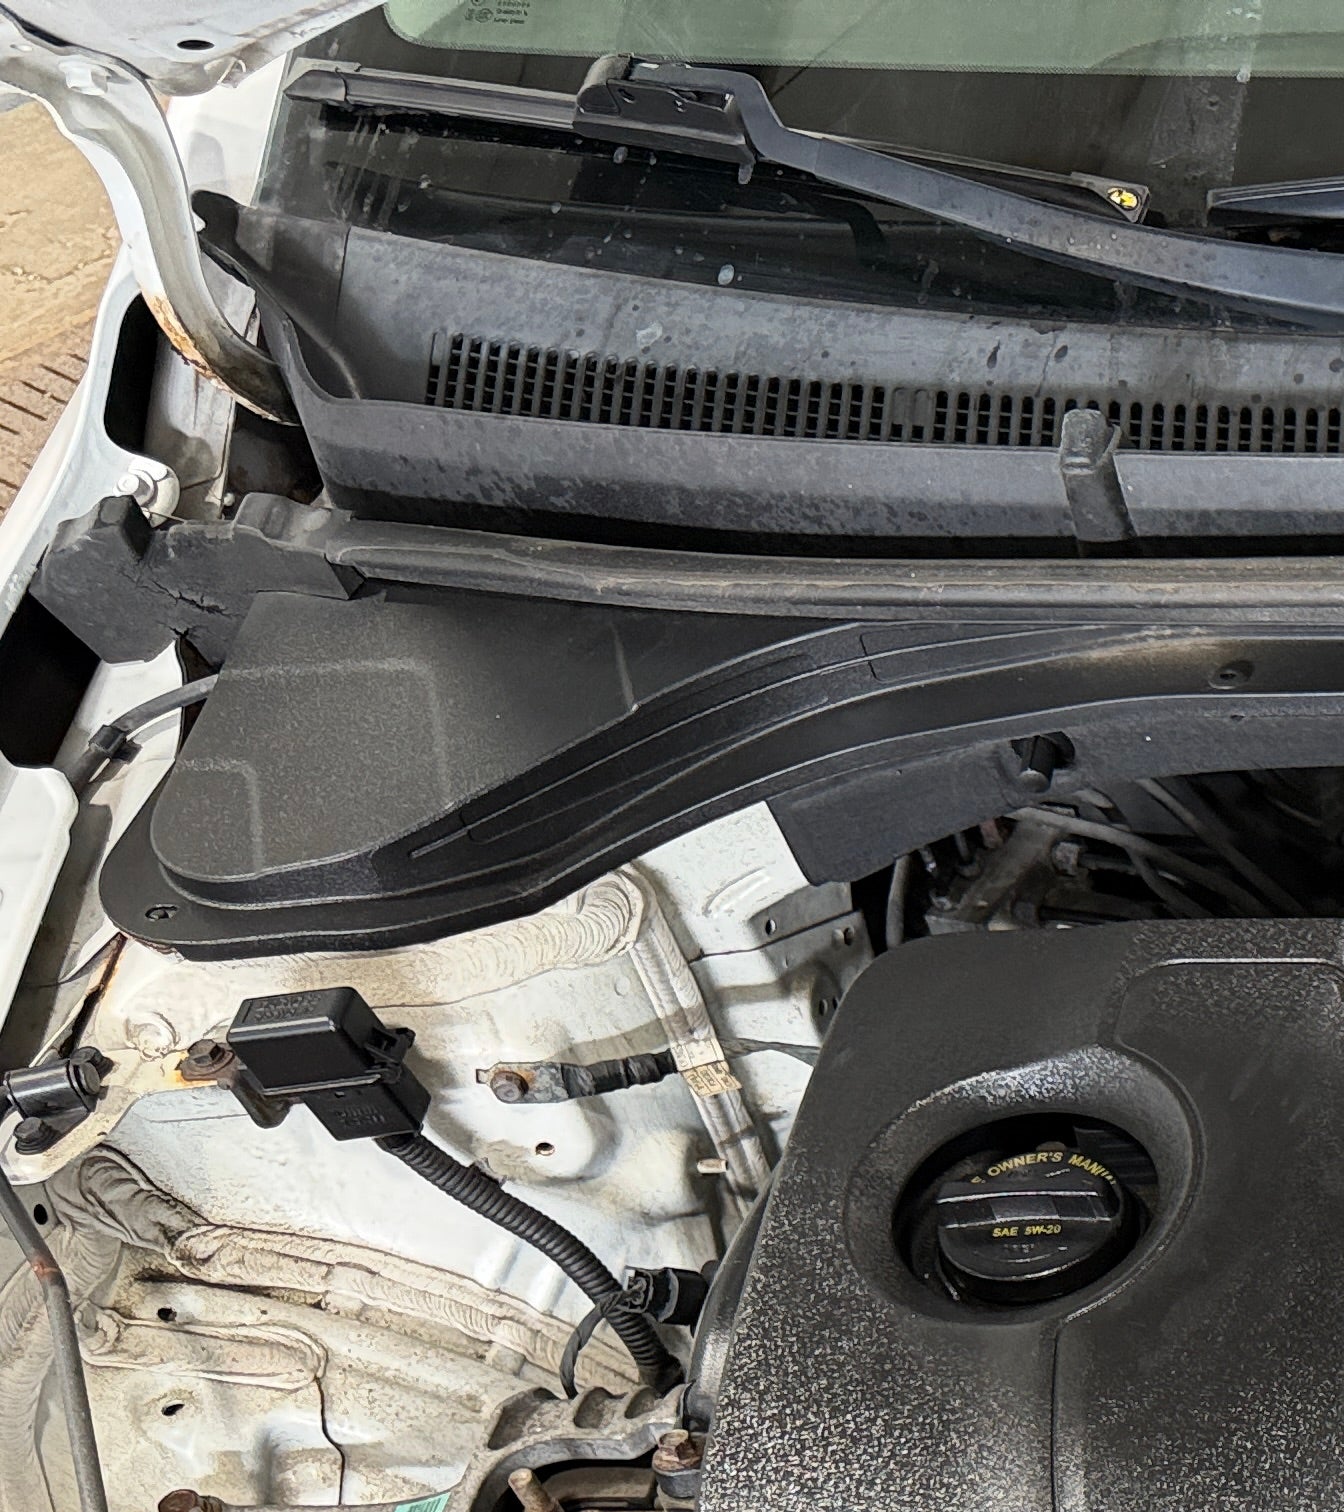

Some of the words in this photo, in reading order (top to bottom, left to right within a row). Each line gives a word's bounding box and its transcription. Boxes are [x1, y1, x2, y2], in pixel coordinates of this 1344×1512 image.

[987, 1151, 1064, 1177] OWNER'S
[992, 1226, 1019, 1238] SAE
[1024, 1224, 1062, 1236] 5W-20
